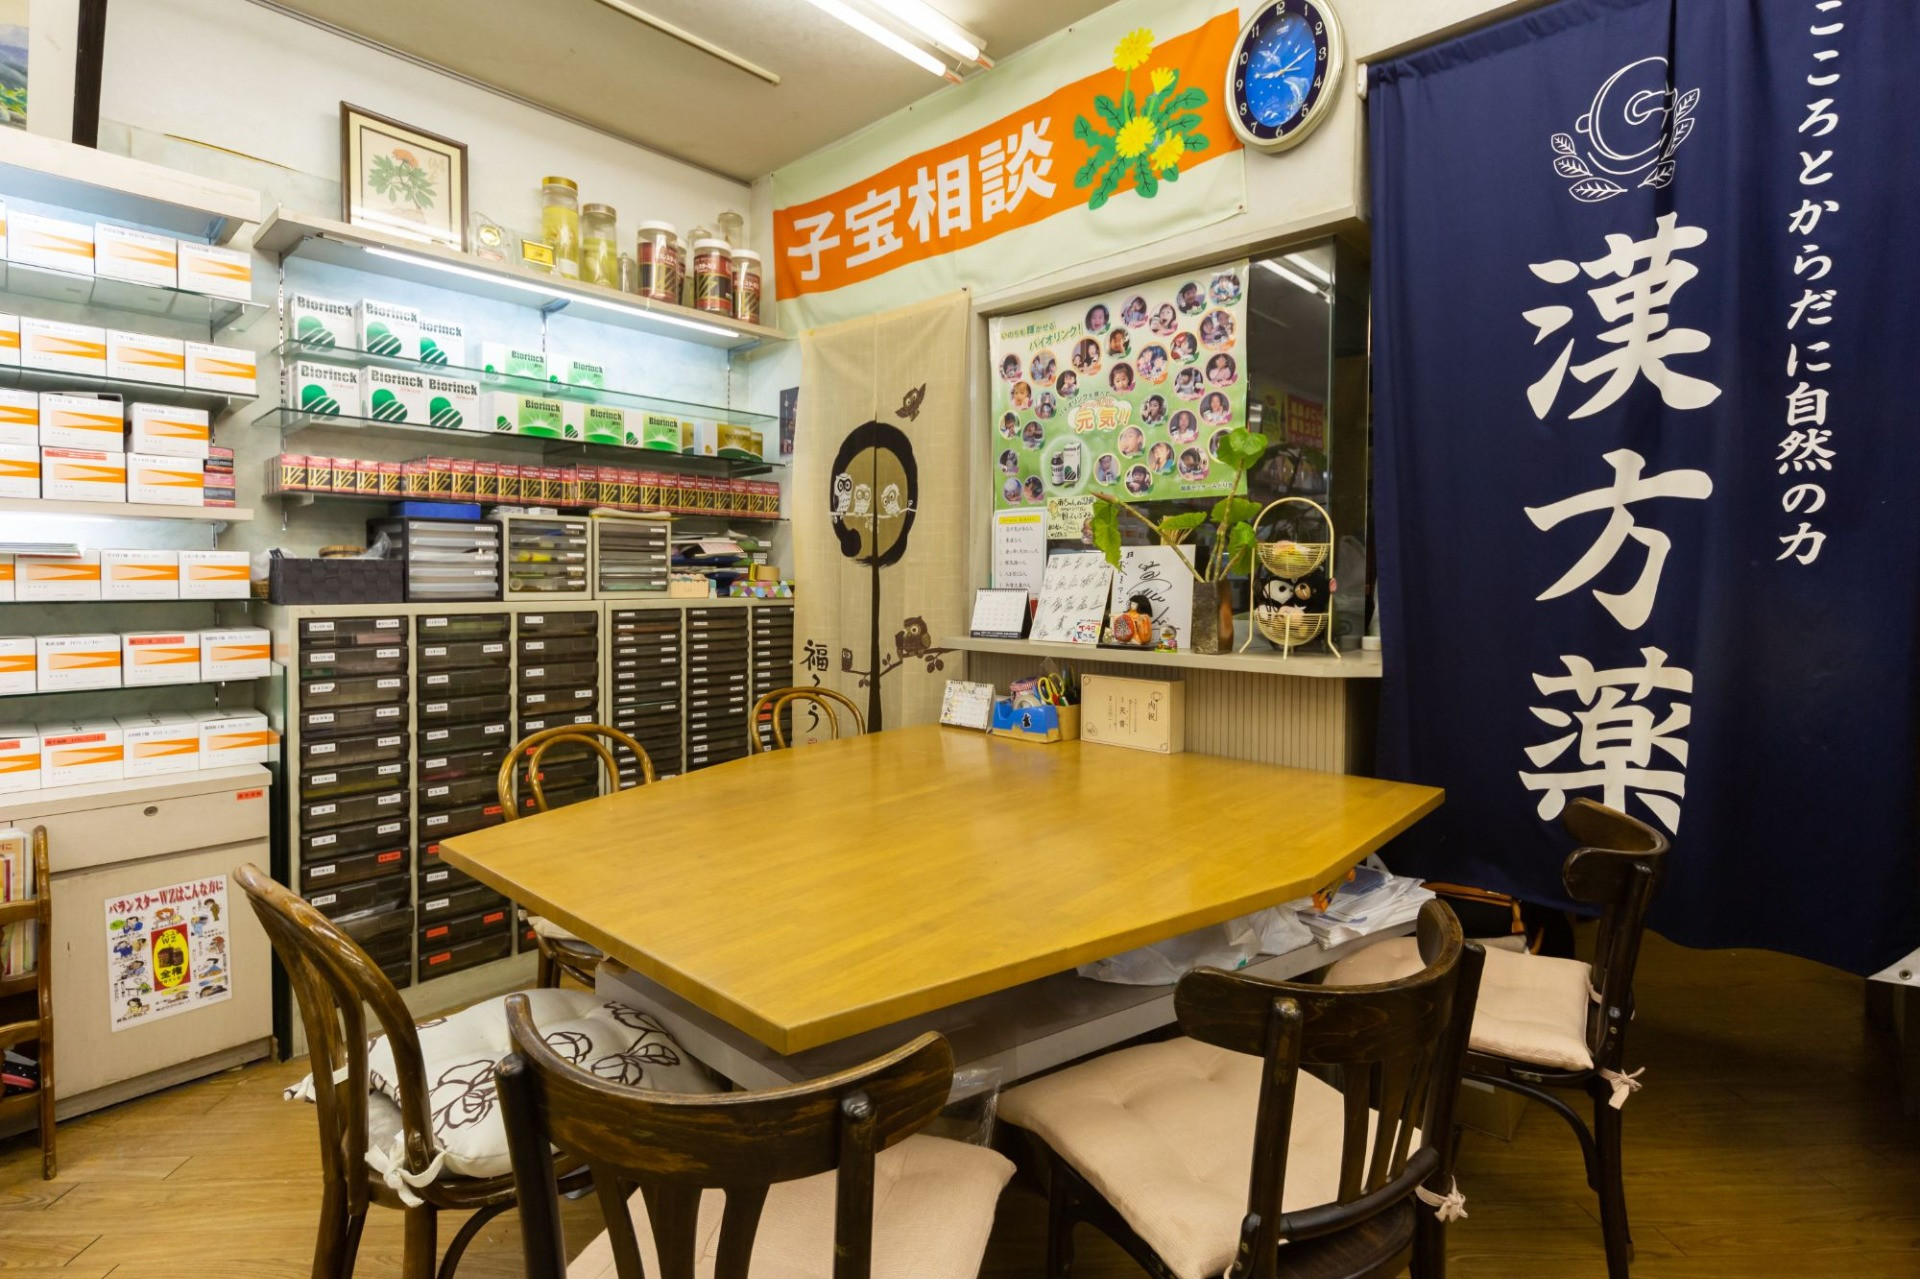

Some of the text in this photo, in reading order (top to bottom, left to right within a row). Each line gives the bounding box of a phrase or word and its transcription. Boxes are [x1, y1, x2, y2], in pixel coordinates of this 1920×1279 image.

[1276, 2, 1286, 16] 12
[1304, 3, 1309, 16] 1
[1252, 25, 1260, 38] 11
[1240, 52, 1249, 65] 10
[1318, 46, 1327, 60] 3
[1236, 79, 1244, 92] 9
[1314, 75, 1323, 88] 4
[1240, 102, 1248, 115] 8
[1301, 104, 1309, 117] 5
[1250, 121, 1258, 134] 7
[1275, 126, 1284, 138] 6
[787, 117, 1057, 281] 子宝相談
[1775, 0, 1845, 566] こころとからだに自然の力
[301, 364, 358, 384] Biorinck
[371, 369, 425, 388] Biorinck
[428, 378, 478, 397] Biorinck
[1519, 211, 1722, 837] 漢方薬
